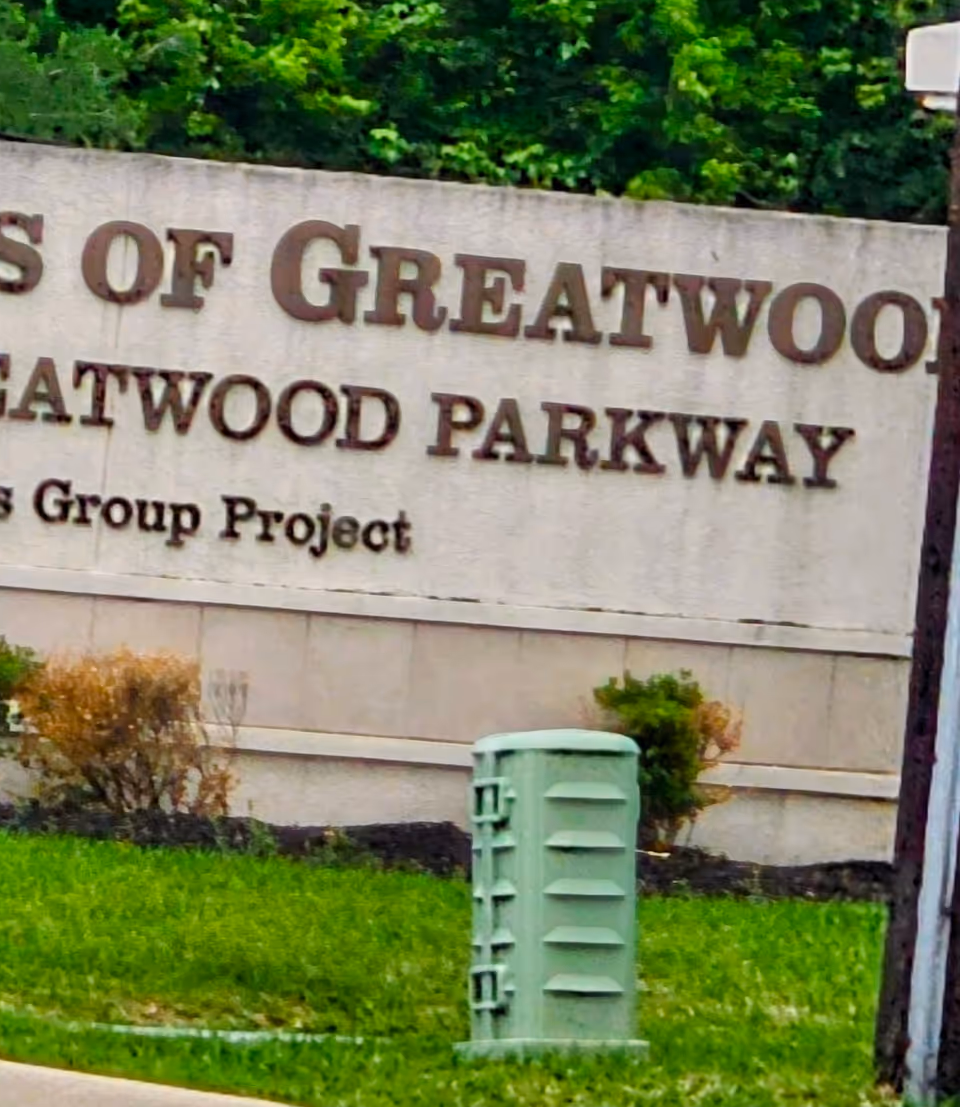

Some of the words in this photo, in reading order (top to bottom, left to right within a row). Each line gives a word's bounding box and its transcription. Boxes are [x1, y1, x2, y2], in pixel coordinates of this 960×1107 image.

[81, 220, 233, 312] OF
[270, 219, 945, 374] GREATWOO
[426, 392, 855, 488] PARKWAY
[33, 478, 201, 547] Group
[220, 495, 411, 558] Project
